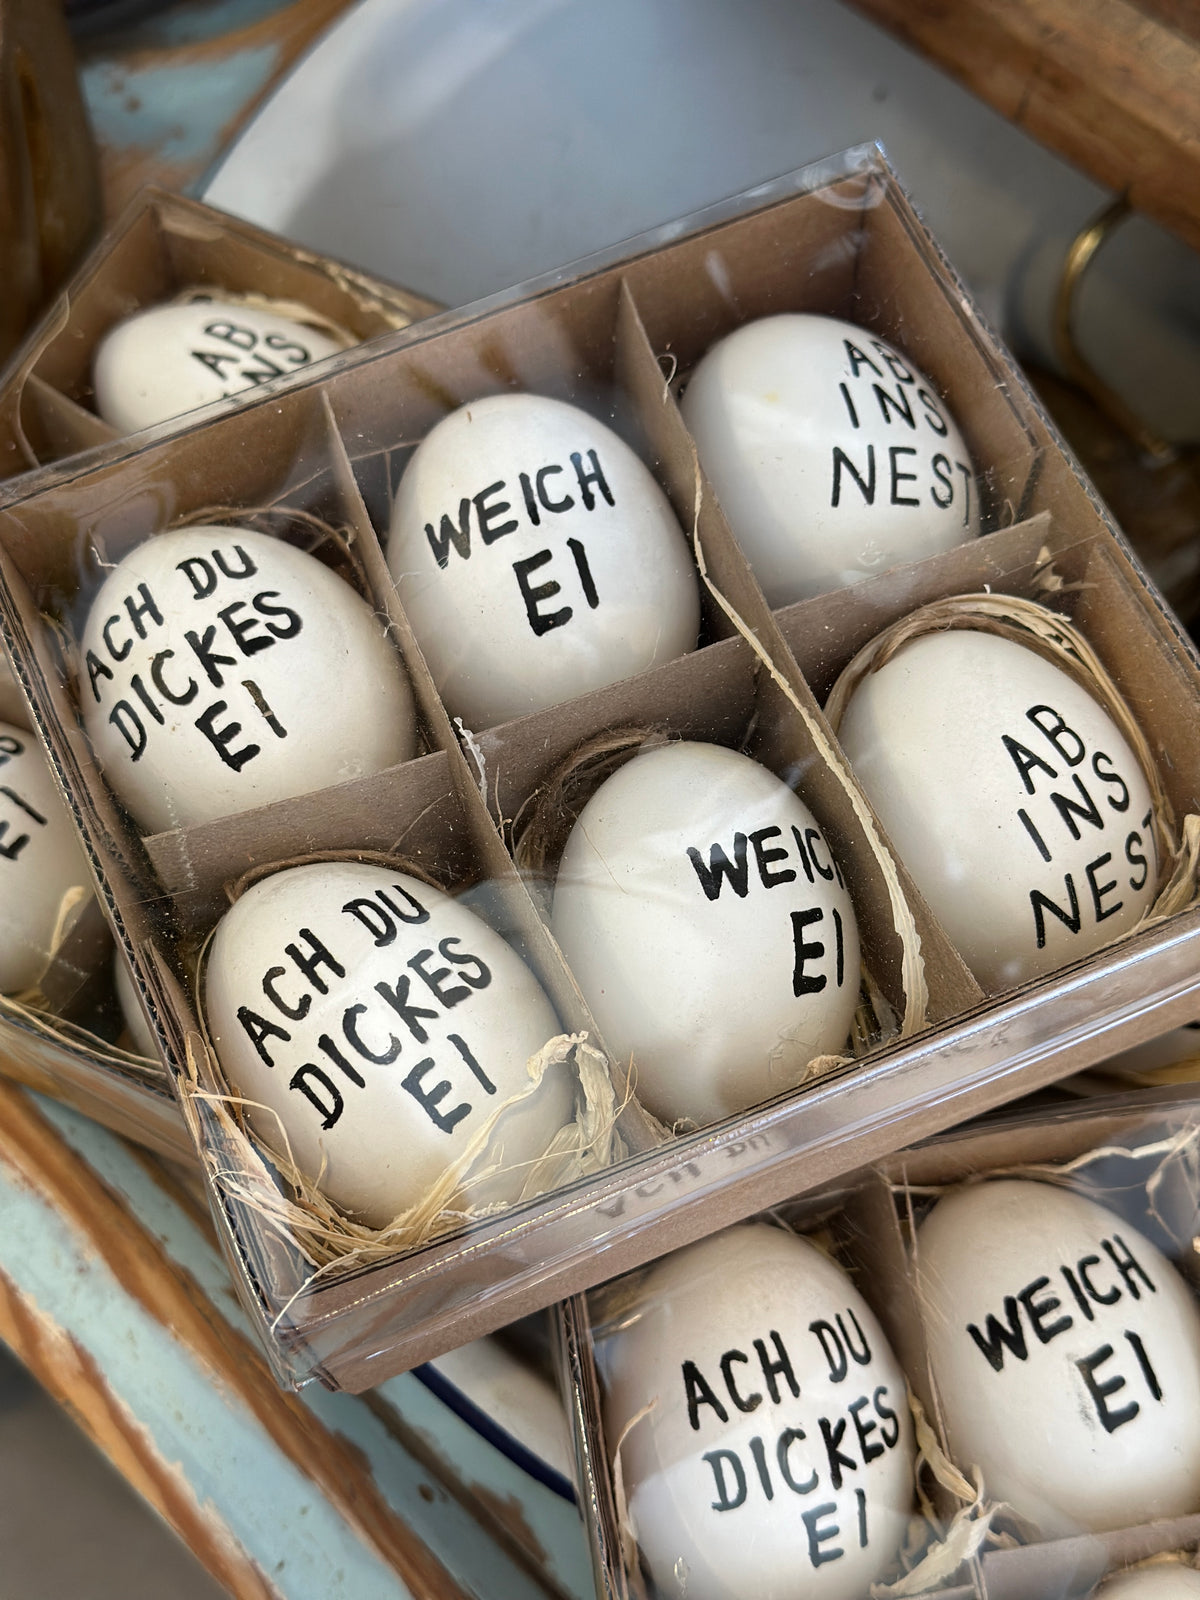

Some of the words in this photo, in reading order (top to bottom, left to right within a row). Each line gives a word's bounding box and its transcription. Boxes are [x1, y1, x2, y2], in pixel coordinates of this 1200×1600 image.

[191, 323, 258, 381] AB
[222, 334, 312, 399] NS
[843, 339, 915, 385] AB
[839, 382, 949, 438] INS
[424, 448, 615, 570] WEICH
[831, 445, 972, 527] NEST
[85, 583, 164, 703] ACH
[176, 545, 258, 600] DU
[512, 537, 600, 636] EI
[109, 590, 303, 763] DICKES
[195, 680, 288, 773] EI
[1001, 704, 1086, 795] AB
[1017, 751, 1129, 862] INS
[687, 825, 845, 901] WEIC
[1029, 808, 1159, 949] NEST
[237, 928, 345, 1068] ACH
[342, 885, 430, 948] DU
[790, 907, 845, 998] EI
[289, 937, 491, 1131] DICKES
[401, 1033, 497, 1134] EI
[966, 1233, 1157, 1373] WEICH
[681, 1330, 800, 1430] ACH
[809, 1308, 872, 1383] DU
[1074, 1330, 1164, 1434] EI
[702, 1385, 899, 1513] DICKES
[801, 1488, 868, 1568] EI
